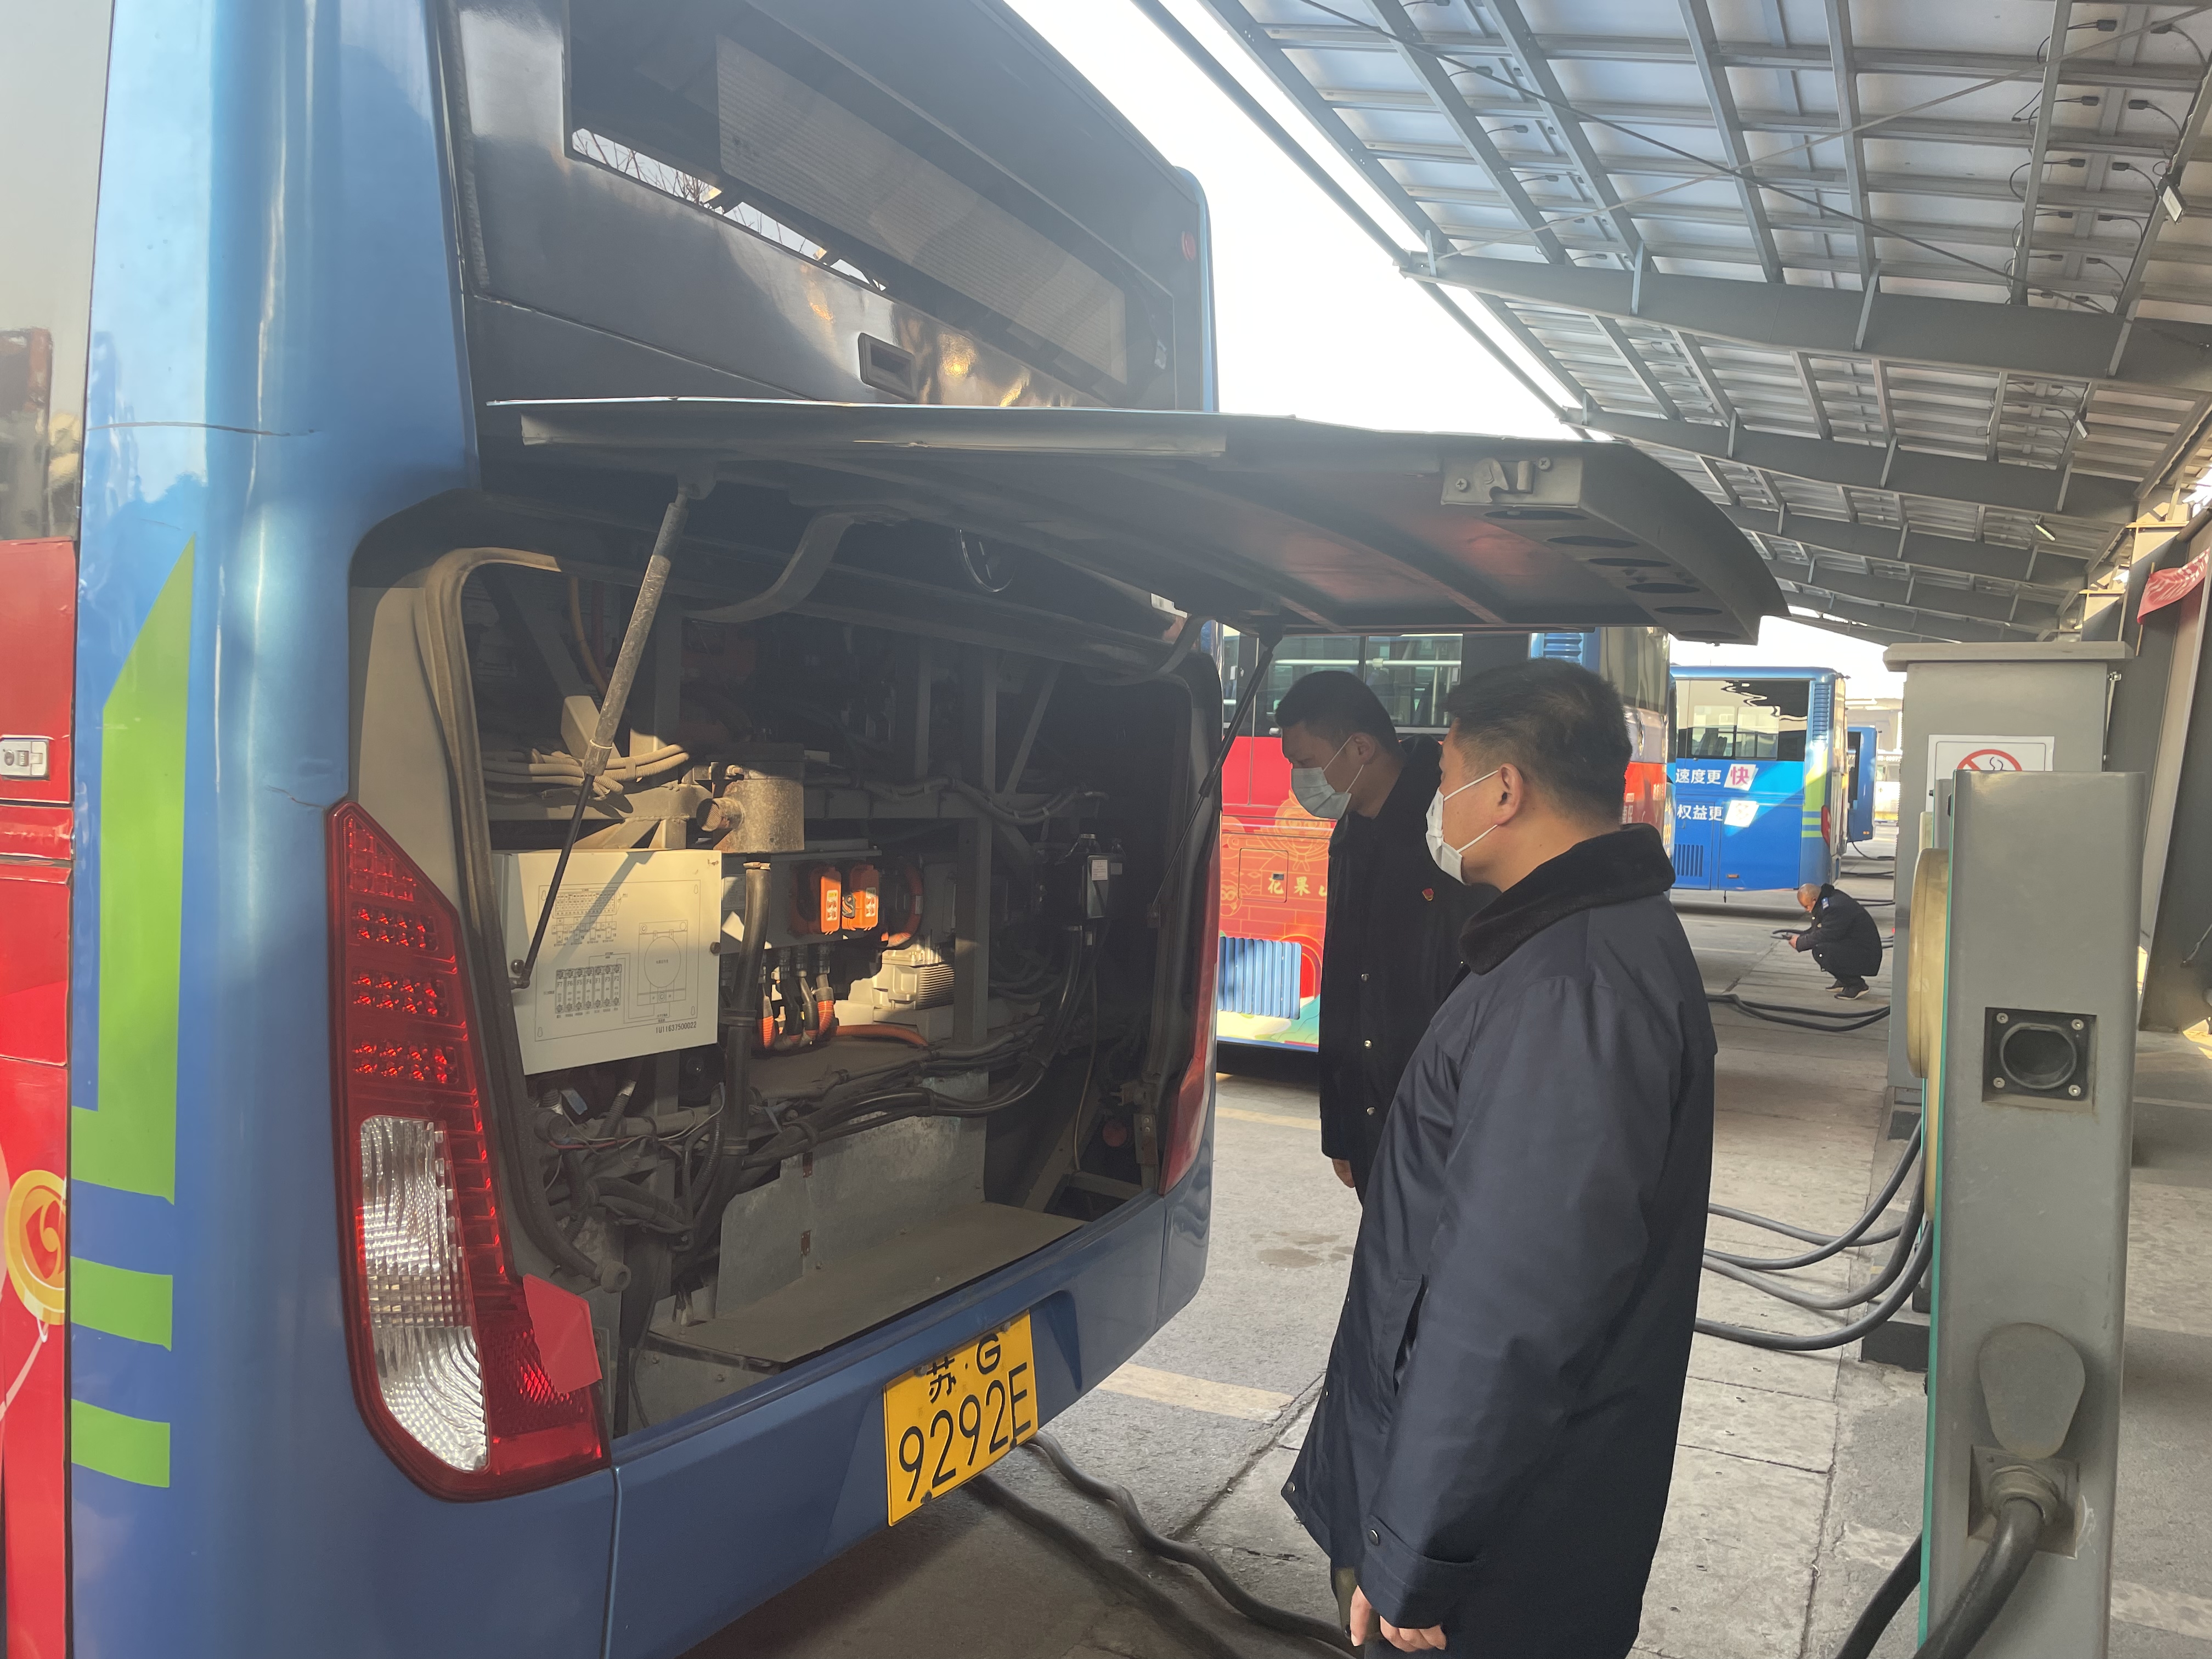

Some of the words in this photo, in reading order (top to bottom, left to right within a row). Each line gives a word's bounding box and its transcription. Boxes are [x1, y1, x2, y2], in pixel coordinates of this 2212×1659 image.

[1675, 766, 1750, 786] 速度更快
[899, 1362, 1031, 1502] 9292E
